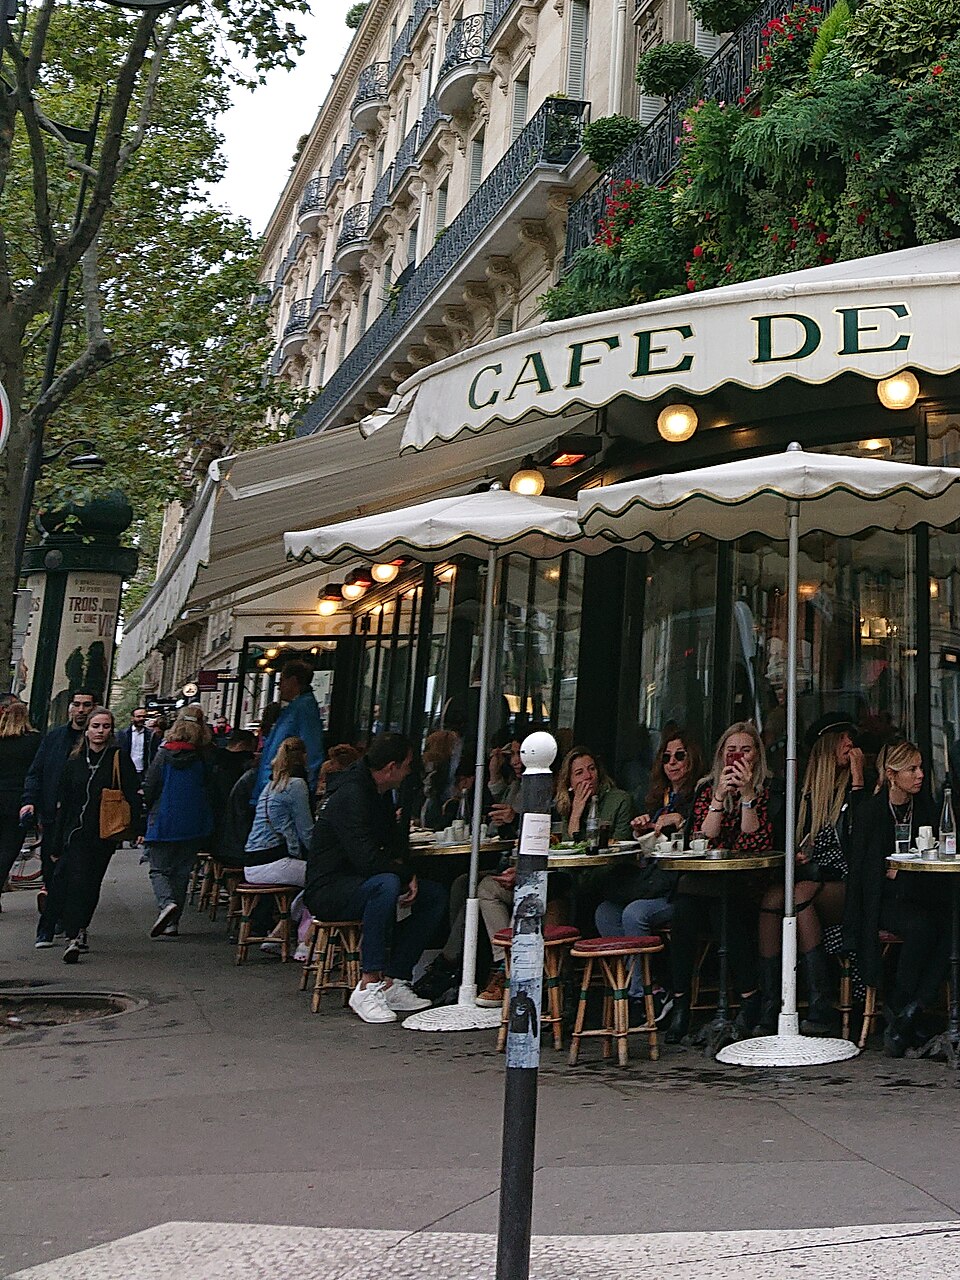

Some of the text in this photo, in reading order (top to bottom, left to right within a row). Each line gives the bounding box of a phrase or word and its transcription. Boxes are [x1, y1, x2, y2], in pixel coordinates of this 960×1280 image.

[468, 323, 695, 411] CAFE
[751, 301, 912, 364] DE
[68, 596, 99, 612] TROIS
